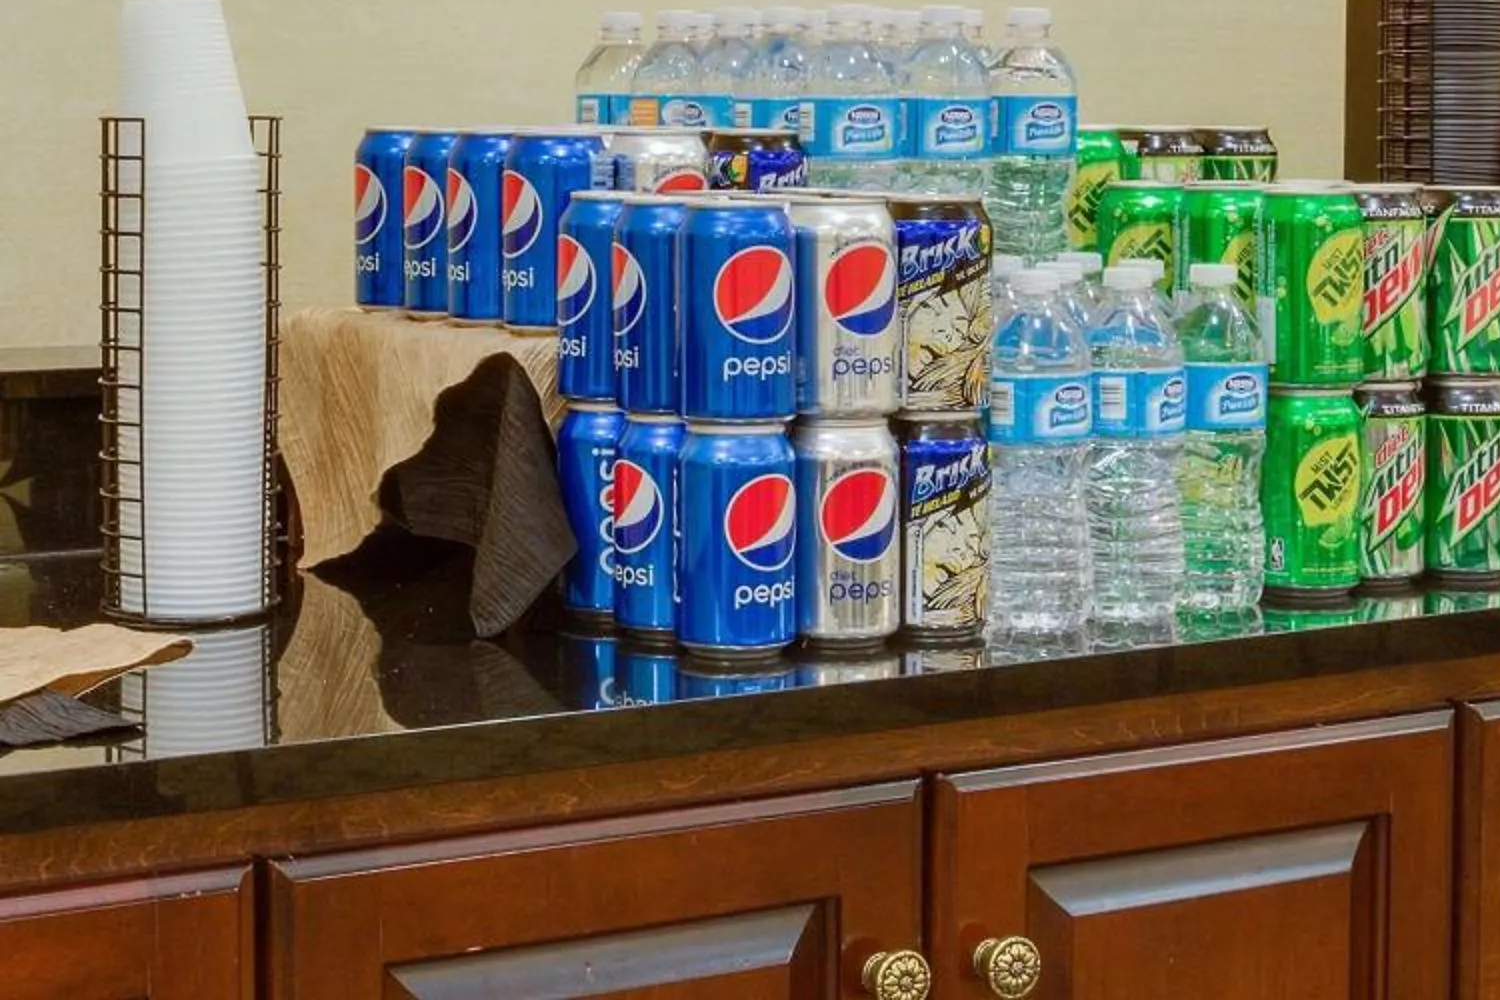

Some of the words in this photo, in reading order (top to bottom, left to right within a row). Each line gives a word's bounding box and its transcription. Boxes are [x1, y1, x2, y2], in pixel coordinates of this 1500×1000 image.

[357, 252, 380, 274] psi
[403, 257, 437, 281] epsi
[447, 261, 470, 283] psi
[502, 266, 535, 291] psi
[557, 335, 587, 360] psi
[614, 345, 640, 371] psi
[723, 350, 791, 382] pepsi
[614, 564, 655, 588] epsi
[735, 574, 795, 610] pepsi
